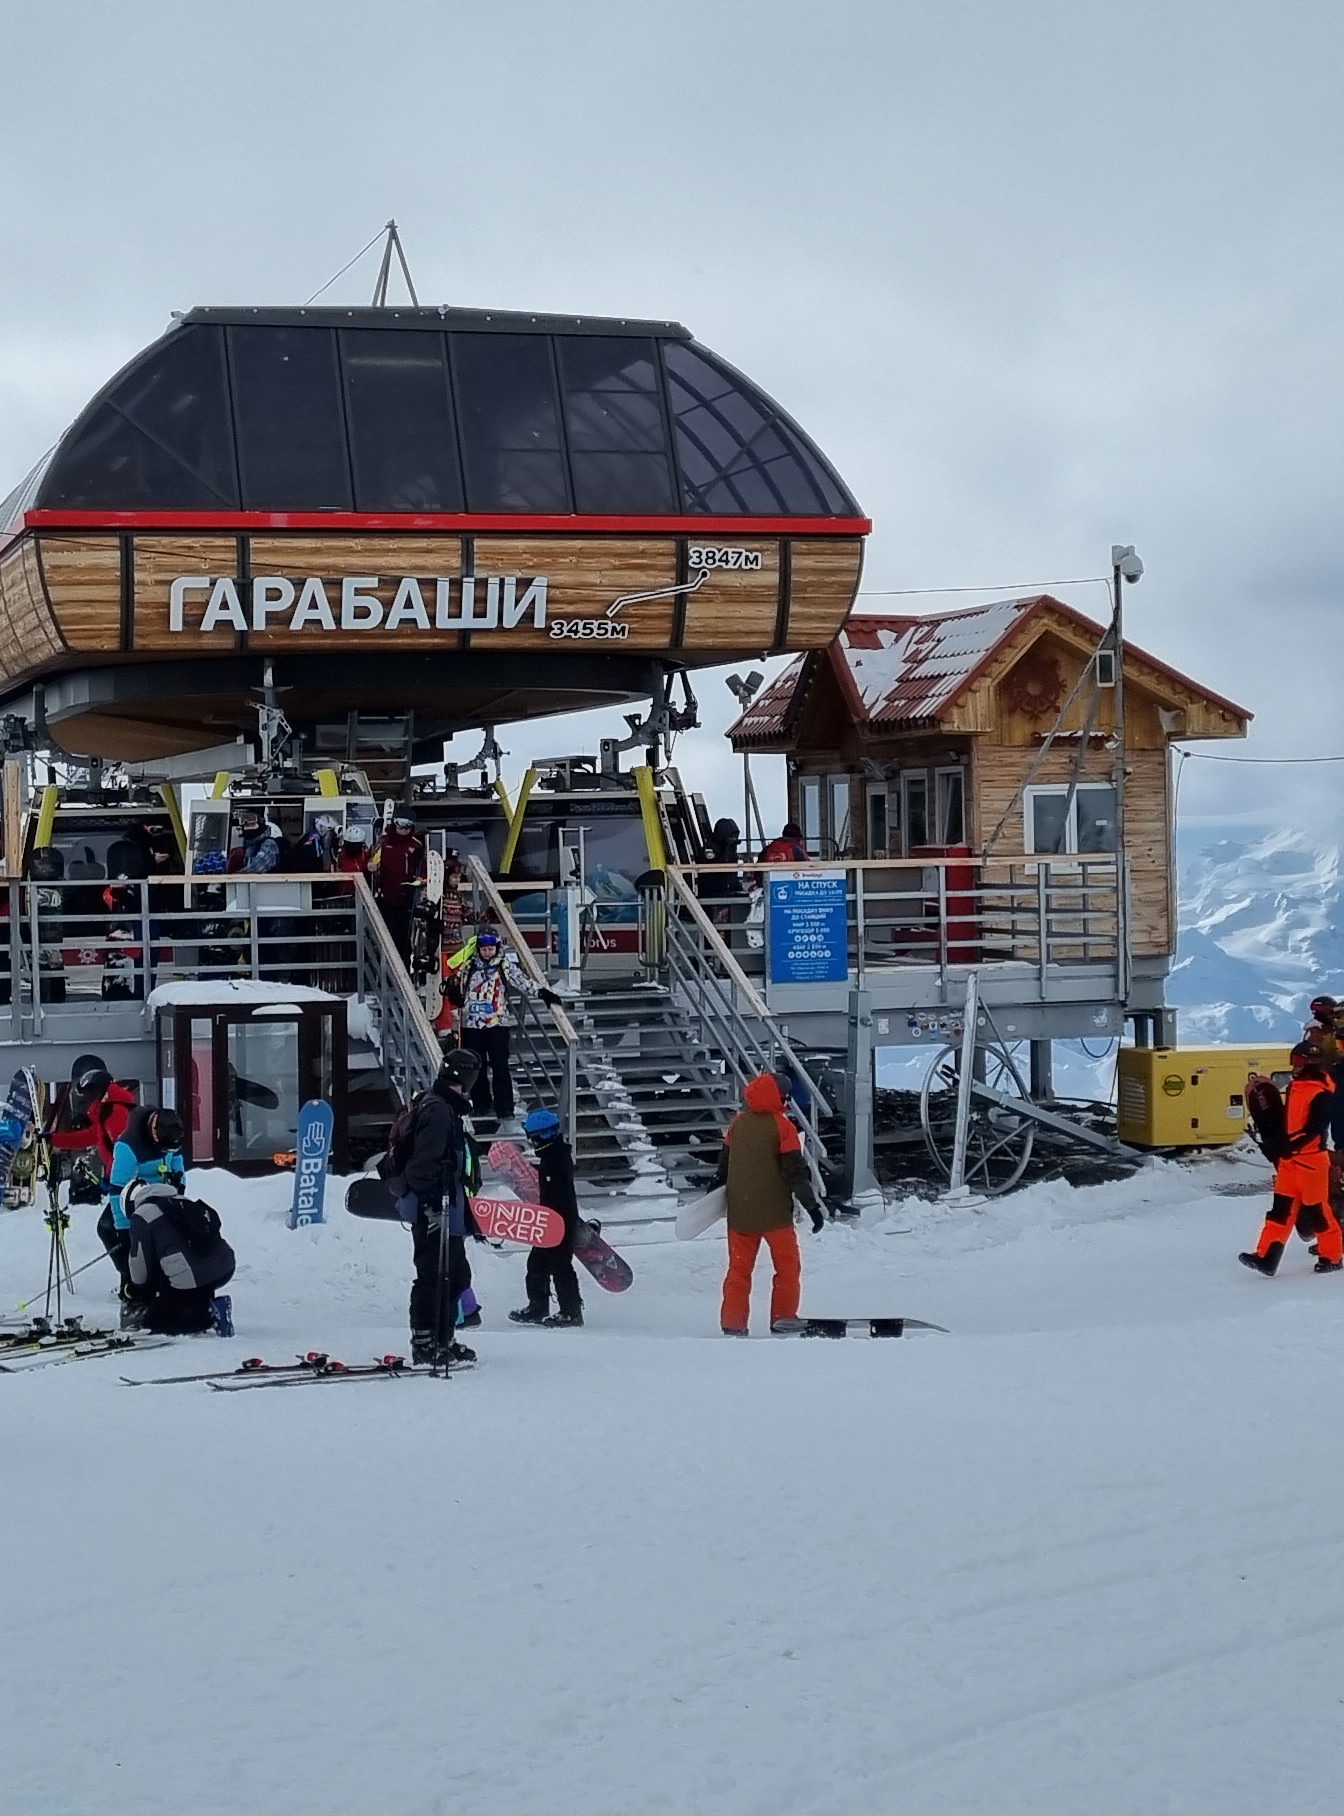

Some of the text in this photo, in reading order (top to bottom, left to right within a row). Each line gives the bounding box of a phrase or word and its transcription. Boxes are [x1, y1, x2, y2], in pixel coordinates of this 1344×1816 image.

[690, 547, 761, 568] 3847м
[169, 576, 548, 631] ГАРАБАШИ
[551, 620, 628, 638] 3455м
[798, 880, 838, 889] НА СПУСК
[496, 1202, 551, 1228] NIDE
[494, 1221, 545, 1244] CKER
